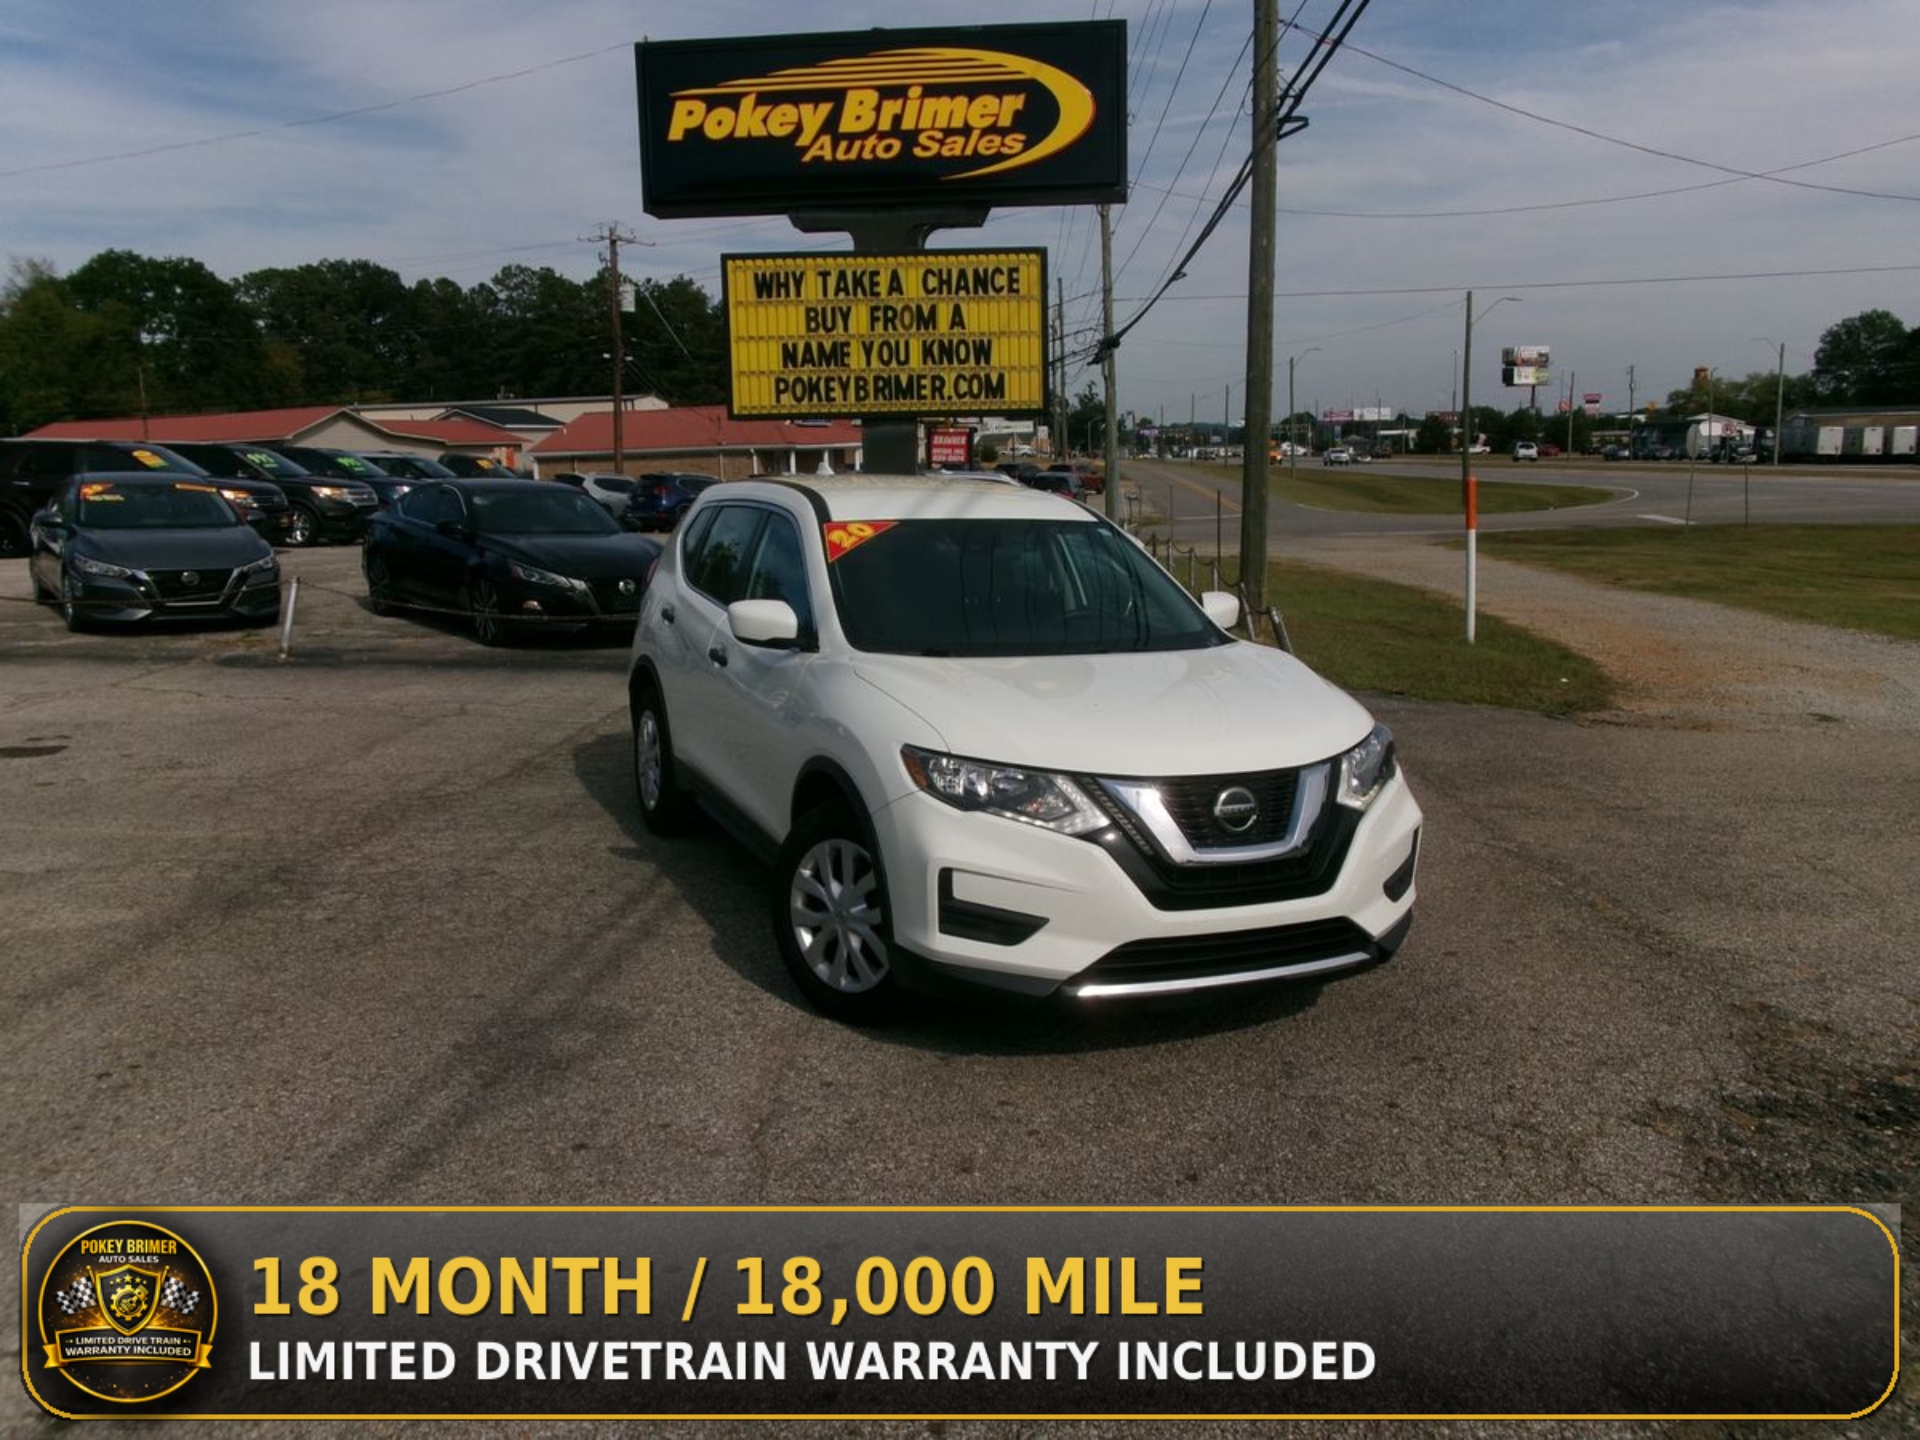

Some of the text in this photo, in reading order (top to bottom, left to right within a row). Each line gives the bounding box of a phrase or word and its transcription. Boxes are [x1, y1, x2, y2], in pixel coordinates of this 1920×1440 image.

[667, 85, 1026, 147] Pokey Brimer
[801, 129, 1027, 163] Auto Sales
[753, 267, 1020, 299] WHY TAKE A CHANCE
[805, 303, 966, 333] BUY FROM A
[781, 338, 992, 369] NAME YOU KNOW
[774, 373, 1006, 404] POKEYBRIMER.COM
